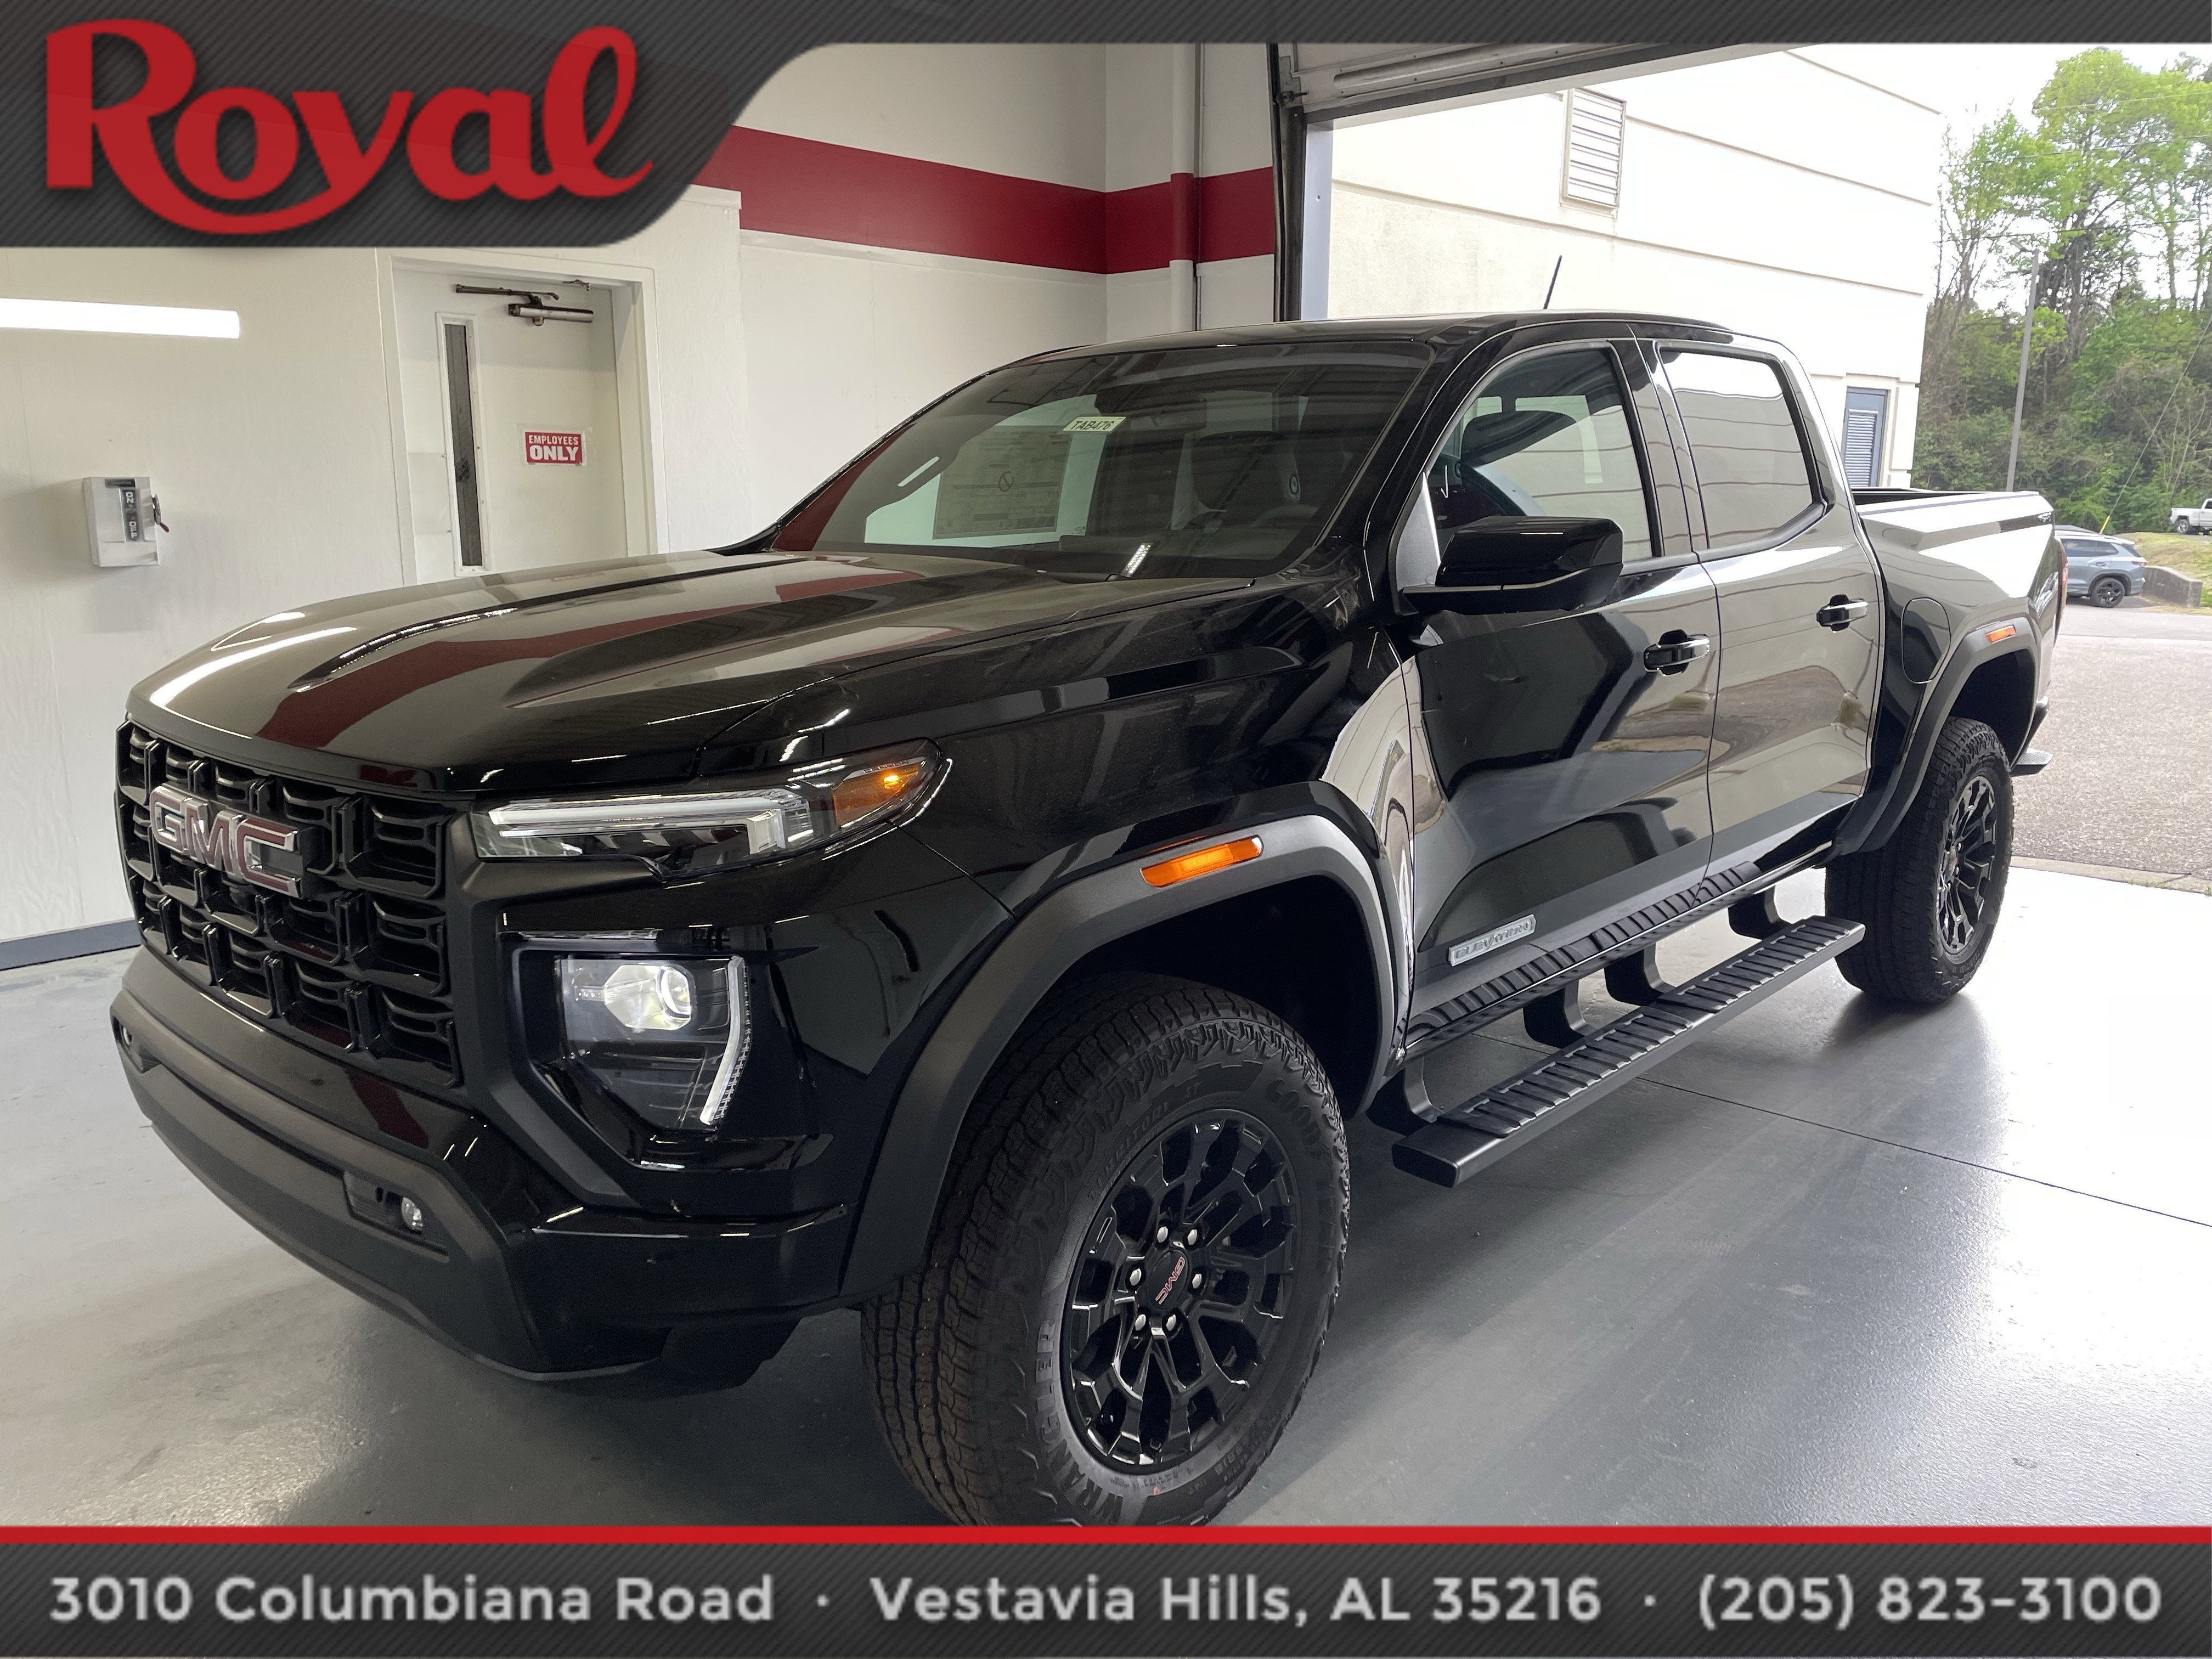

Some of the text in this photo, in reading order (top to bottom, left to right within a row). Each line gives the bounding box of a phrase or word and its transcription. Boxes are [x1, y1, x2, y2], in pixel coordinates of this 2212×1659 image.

[1070, 421, 1114, 430] TAB476
[528, 435, 579, 445] EMPLOYEES
[529, 445, 579, 461] ONLY
[150, 785, 301, 898] GMC
[1155, 1256, 1186, 1305] GMC
